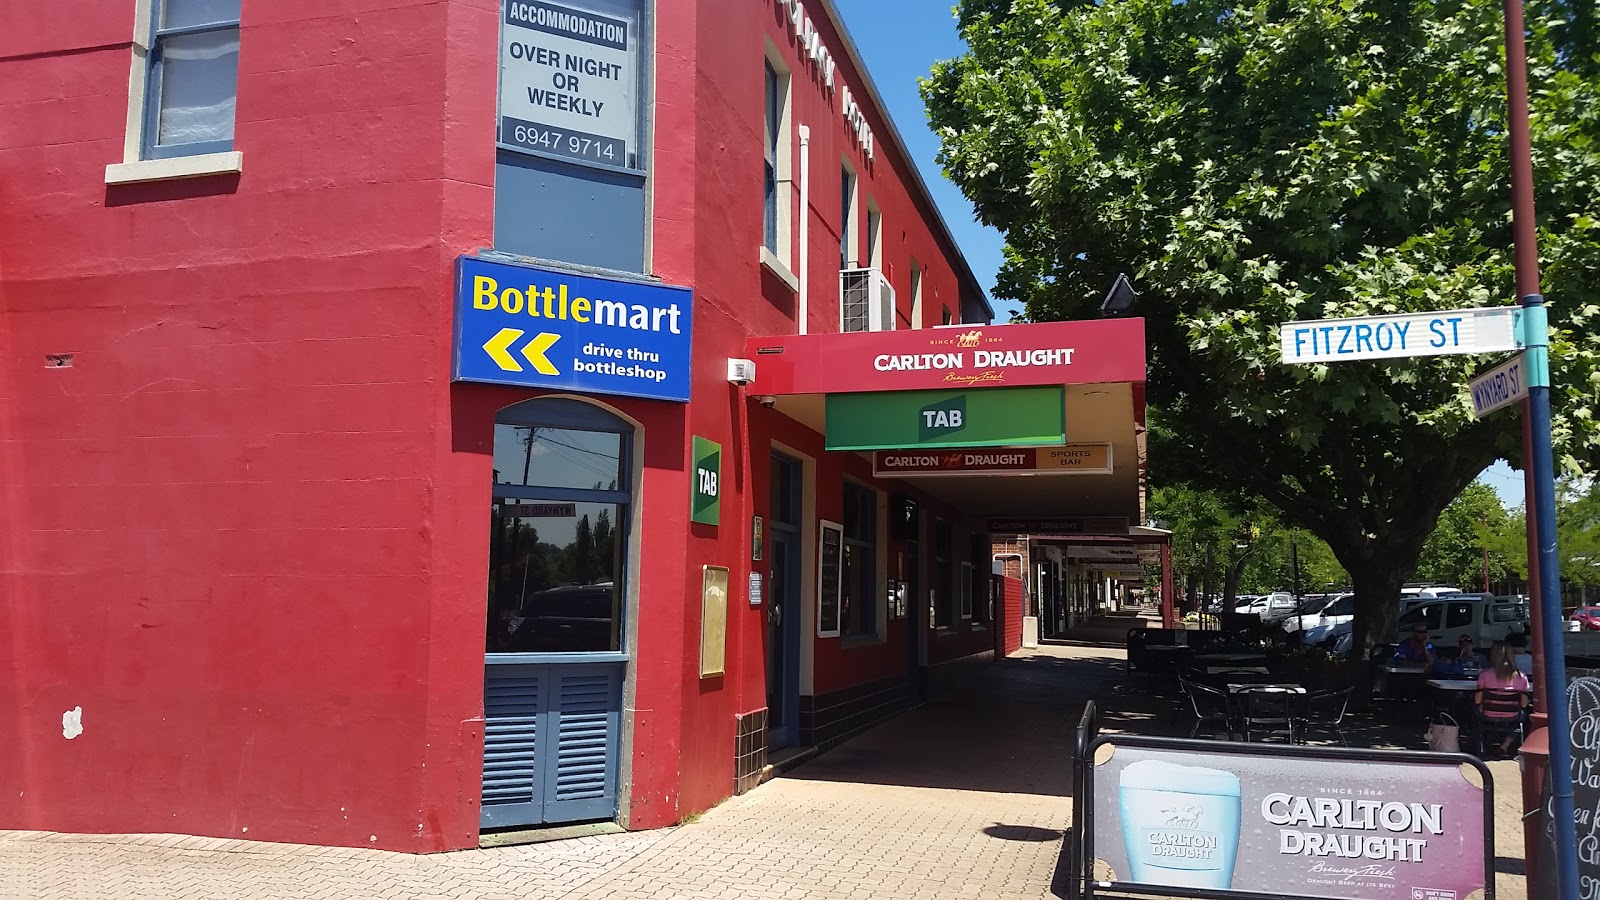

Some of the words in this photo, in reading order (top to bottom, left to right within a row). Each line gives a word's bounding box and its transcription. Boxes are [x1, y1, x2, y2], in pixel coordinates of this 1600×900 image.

[510, 2, 624, 43] ACCOMMODATION
[509, 41, 561, 68] OVER
[565, 54, 622, 81] NIGHT
[552, 72, 579, 93] OR
[527, 86, 604, 118] WEEKLY
[842, 85, 876, 164] HOTEL
[514, 125, 563, 149] 6947
[568, 136, 615, 160] 9714
[473, 275, 682, 335] Bottlemart
[1295, 321, 1411, 357] FITZROY
[1429, 318, 1463, 348] ST
[582, 342, 624, 359] drive
[627, 348, 660, 363] thru
[873, 352, 963, 371] CARLTON
[974, 348, 1075, 368] DRAUGHT
[573, 358, 667, 383] bottleshop
[978, 370, 1005, 382] Fresh
[1472, 372, 1509, 411] WYNYARD
[1509, 364, 1520, 395] ST
[922, 410, 963, 428] TAB
[884, 455, 939, 467] CARLTON
[964, 454, 1026, 466] DRAUGHT
[1050, 450, 1091, 458] SPORTS
[698, 468, 717, 497] TAB
[1040, 521, 1077, 529] DRAUGHT
[1320, 787, 1353, 795] SINCE
[1261, 793, 1444, 835] CARLTON
[1149, 832, 1218, 849] CARLTON
[1280, 829, 1428, 862] DRAUGHT
[1152, 846, 1212, 860] DRAUGHT
[1308, 861, 1359, 881] Brewery
[1358, 864, 1396, 880] Fresh
